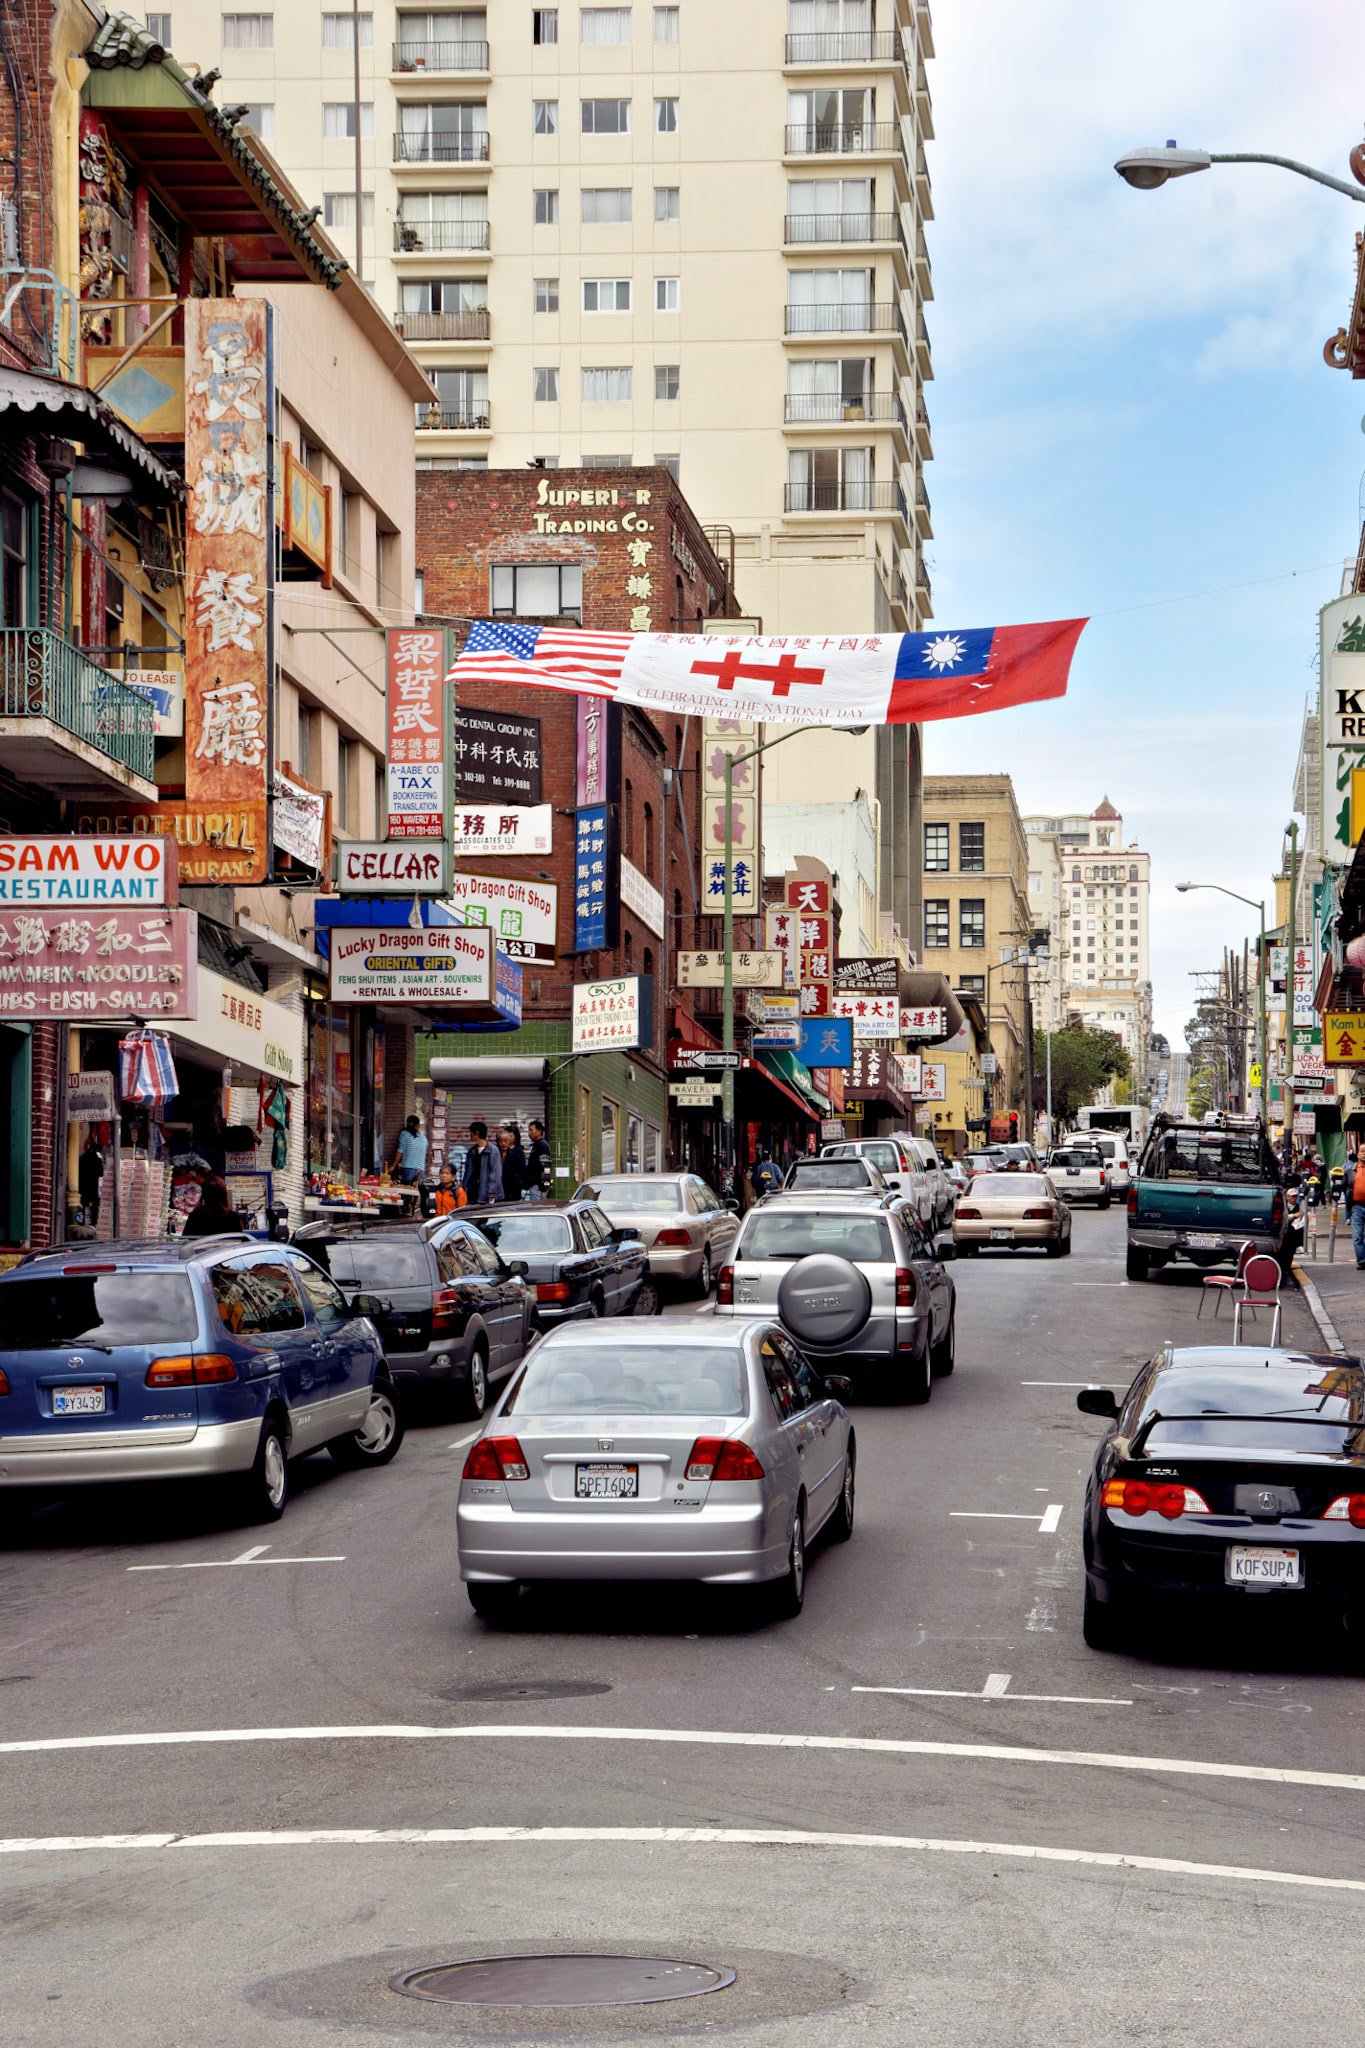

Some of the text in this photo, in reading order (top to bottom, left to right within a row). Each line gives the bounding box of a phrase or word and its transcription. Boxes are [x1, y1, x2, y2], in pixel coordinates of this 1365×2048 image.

[533, 512, 618, 534] TRADING
[140, 673, 177, 684] LEASE
[393, 634, 440, 734] 梁哲武
[636, 687, 866, 718] CELEBRATING THE NATIONAL DAY
[469, 719, 496, 732] DENTAL
[497, 723, 522, 736] GROUP
[390, 766, 423, 775] A-AABE
[398, 777, 433, 789] TAX
[393, 792, 438, 800] BOOKKEEPING
[393, 803, 438, 811] TRANSLATION
[403, 815, 430, 825] WAVERLY
[0, 844, 161, 872] SAM WO
[345, 853, 441, 881] CELLAR
[0, 878, 159, 899] RESTAURANT
[470, 878, 551, 916] Dragon Gift Shop
[337, 932, 485, 961] Lucky Dragon Gift Shop
[367, 956, 455, 969] ORIENTAL GIFTS
[338, 975, 482, 984] FENG SHUI ITEMS ASIAN ART SOUVENIRS
[358, 987, 462, 997] RENTAIL & WHOLESALE
[1331, 1018, 1354, 1030] Kam
[264, 1043, 293, 1077] Gift Shop
[721, 1055, 737, 1063] WAY
[80, 1076, 109, 1087] PARKING
[674, 1085, 716, 1094] WAVERLY
[1145, 1467, 1179, 1476] ACURA
[579, 1476, 635, 1493] 5PFT609
[1245, 1549, 1285, 1560] California
